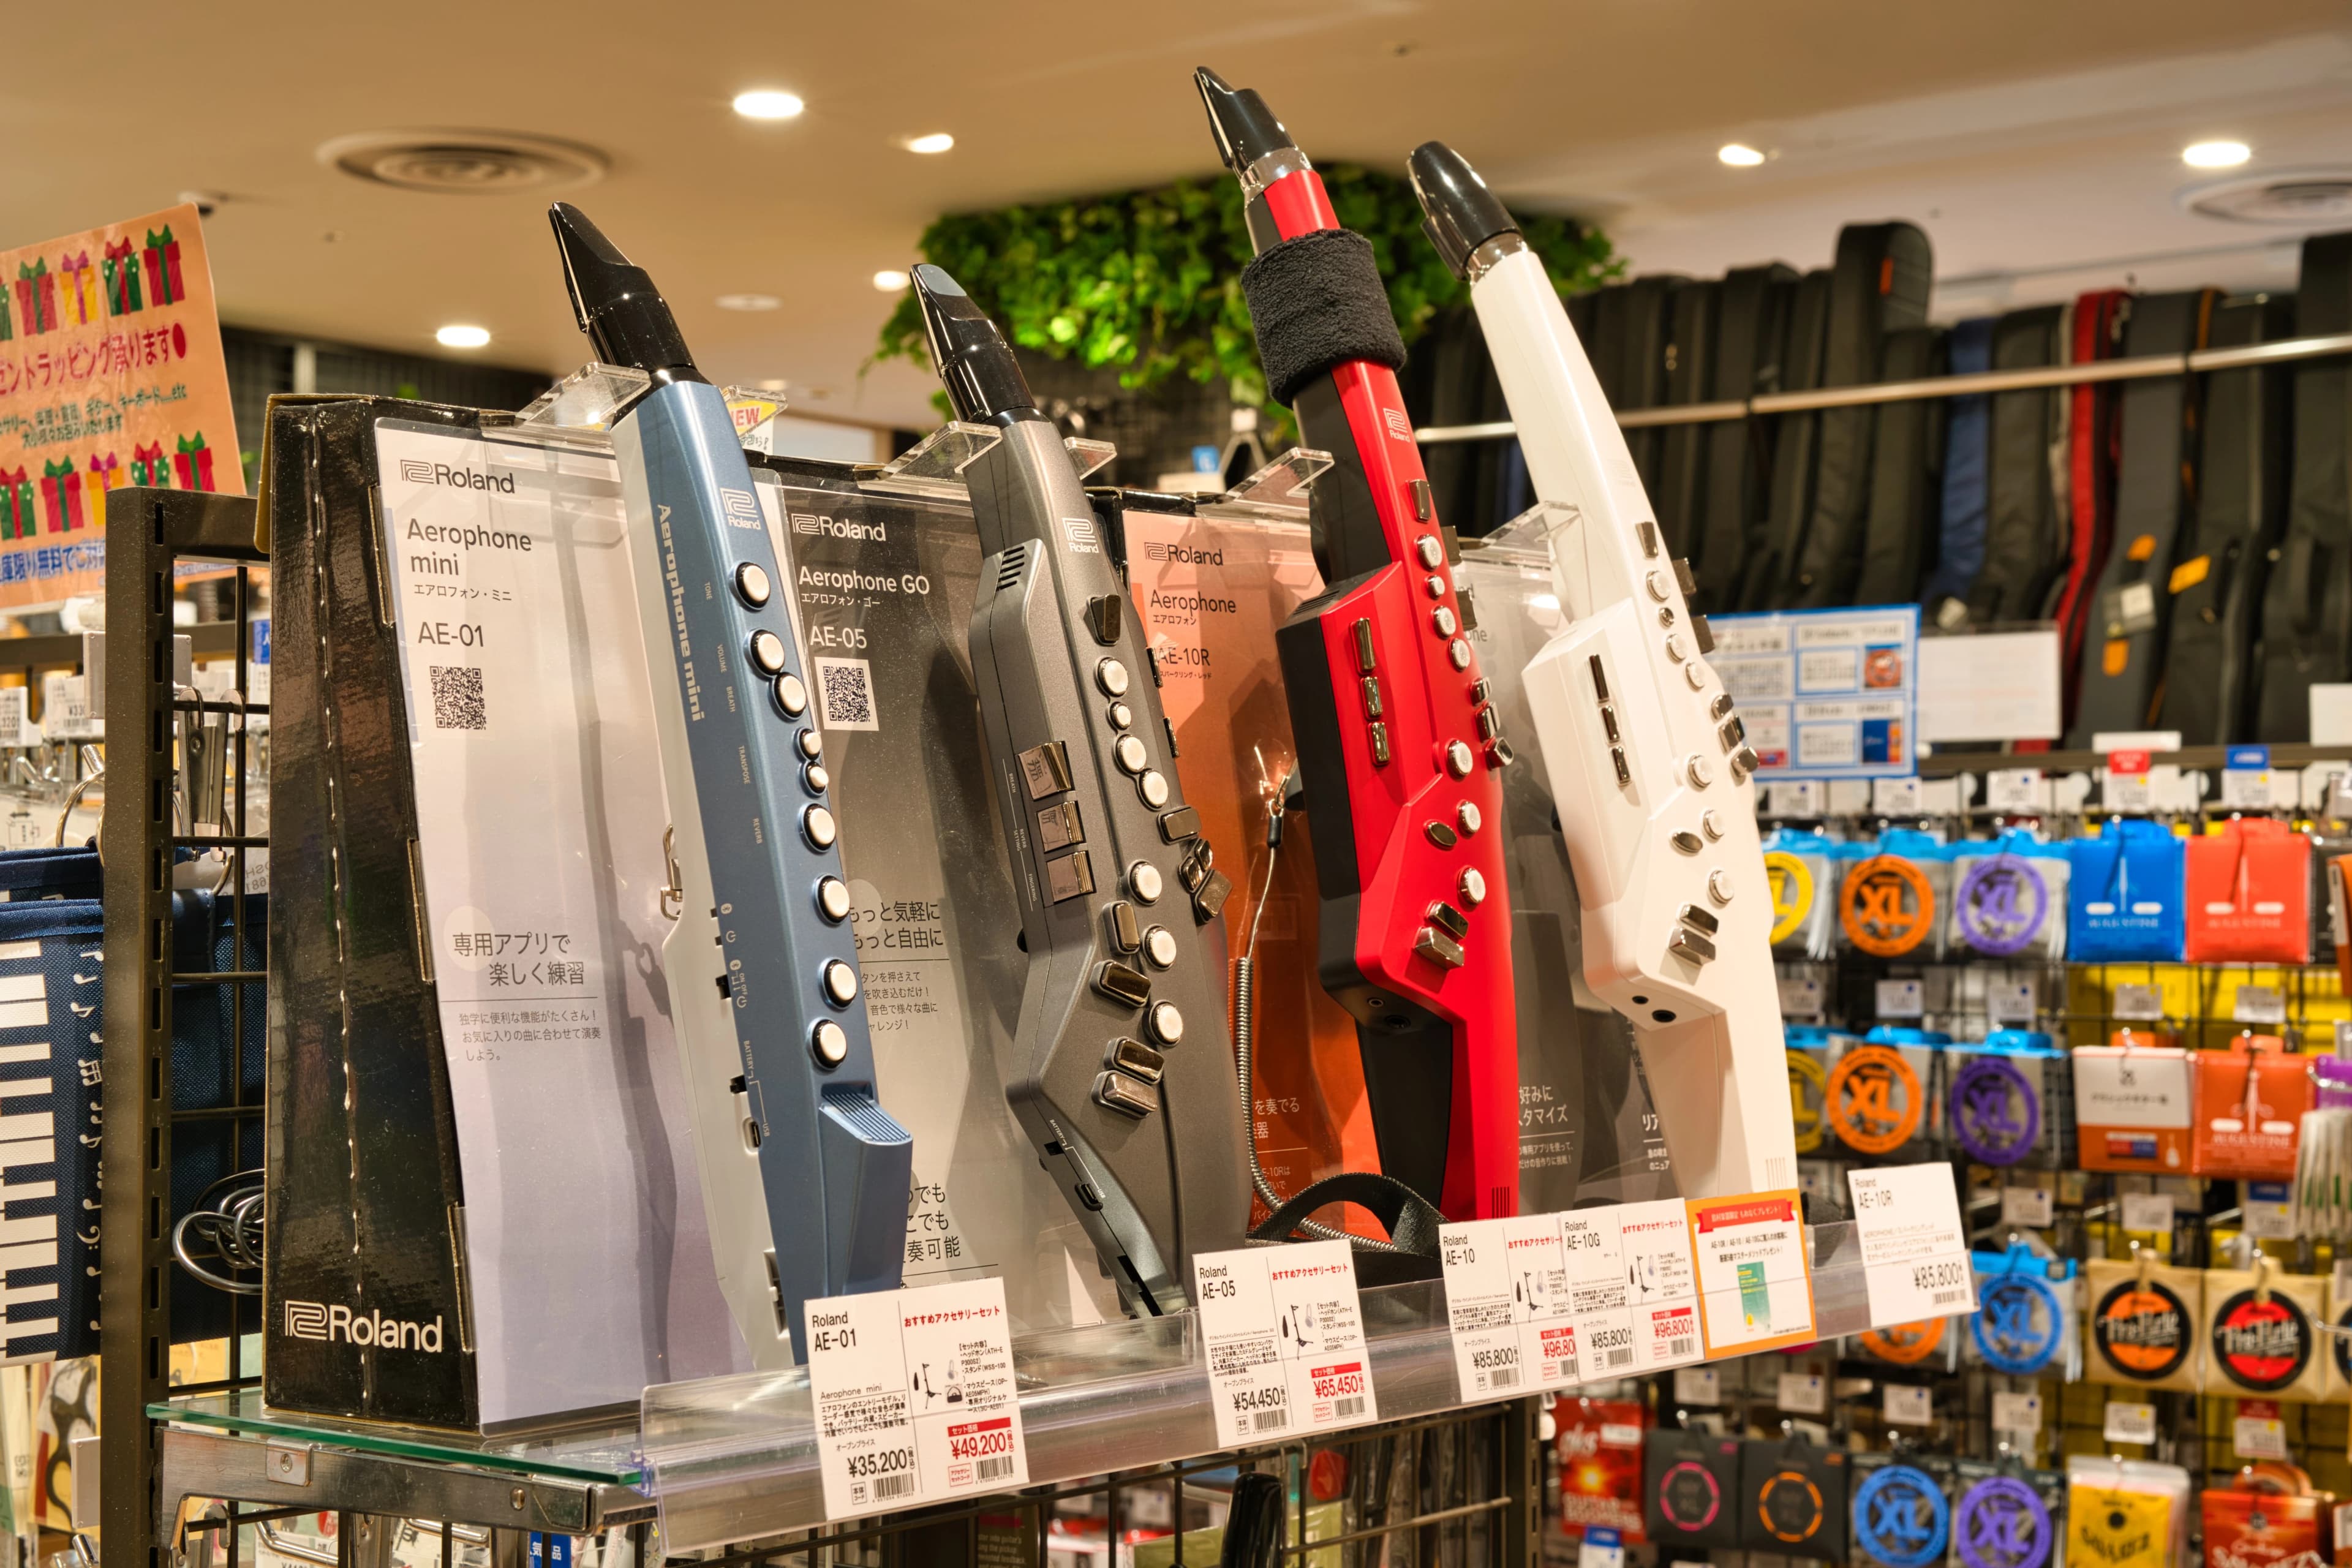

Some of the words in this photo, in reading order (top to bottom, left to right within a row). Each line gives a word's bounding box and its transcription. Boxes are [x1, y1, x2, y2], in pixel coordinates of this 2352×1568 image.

[1389, 429, 1411, 443] Roland
[434, 464, 515, 494] Roland
[728, 516, 761, 531] Roland
[819, 516, 886, 542] Roland
[407, 518, 532, 552] Aerophone
[1068, 542, 1099, 554] Roland
[1167, 544, 1223, 567] Roland
[410, 551, 460, 576] mini
[703, 581, 712, 601] TONE
[799, 565, 897, 593] Aerophone
[902, 574, 930, 595] GO
[414, 584, 513, 601] エアロフォン・ミニ
[801, 593, 881, 608] エアロフォン・ゴー
[1150, 589, 1237, 616] Aerophone
[657, 503, 692, 660] Aerophone
[683, 660, 705, 723] mini
[1153, 614, 1197, 625] エアロフォン
[418, 622, 484, 648] AE-01
[810, 625, 867, 649] AE-05
[716, 644, 728, 674] VOLUME
[1158, 647, 1210, 666] AE-10R
[725, 685, 736, 713] BREATH
[737, 745, 750, 785] TRANSPOSE
[752, 818, 763, 844] REVERB
[1028, 873, 1038, 902] FINGERING
[452, 931, 571, 957] 専用アプリで
[489, 961, 584, 987] 楽しく練習
[459, 1009, 597, 1026] 独学に便利な機能がたくさん！
[870, 1002, 938, 1016] 音色で様々な曲に
[462, 1027, 601, 1044] お気に入りの曲に合わせて演奏
[466, 1049, 501, 1061] しよう。
[743, 1040, 754, 1070] BATTERY
[1050, 1119, 1065, 1139] BATTERY
[1097, 1189, 1106, 1199] USB
[1855, 1178, 1876, 1188] Roland
[1860, 1189, 1893, 1209] AE-10R
[1565, 1220, 1588, 1232] Roland
[1443, 1234, 1468, 1246] Roland
[1567, 1232, 1600, 1251] AE-10G
[1446, 1248, 1475, 1267] AE-10
[1199, 1265, 1227, 1279] Roland
[1272, 1262, 1349, 1281] おすすめアクセサリーセット
[1913, 1262, 1959, 1291] ¥85,800
[1202, 1280, 1236, 1300] AE-05
[812, 1311, 848, 1328] Roland
[904, 1305, 1000, 1328] おすすめアクセサリーセット
[329, 1305, 442, 1353] Roland
[814, 1328, 857, 1352] AE-01
[1591, 1328, 1628, 1350] ¥85,800
[1654, 1319, 1689, 1339] ¥96,800
[1472, 1348, 1513, 1370] ¥85,800
[820, 1387, 861, 1400] Aerophone
[866, 1383, 883, 1393] mini
[1314, 1375, 1359, 1399] ¥65,450
[1233, 1387, 1280, 1412] ¥54,450
[951, 1424, 978, 1435] セット価格
[951, 1432, 1006, 1460] ¥49,200
[847, 1449, 908, 1478] ¥35,200
